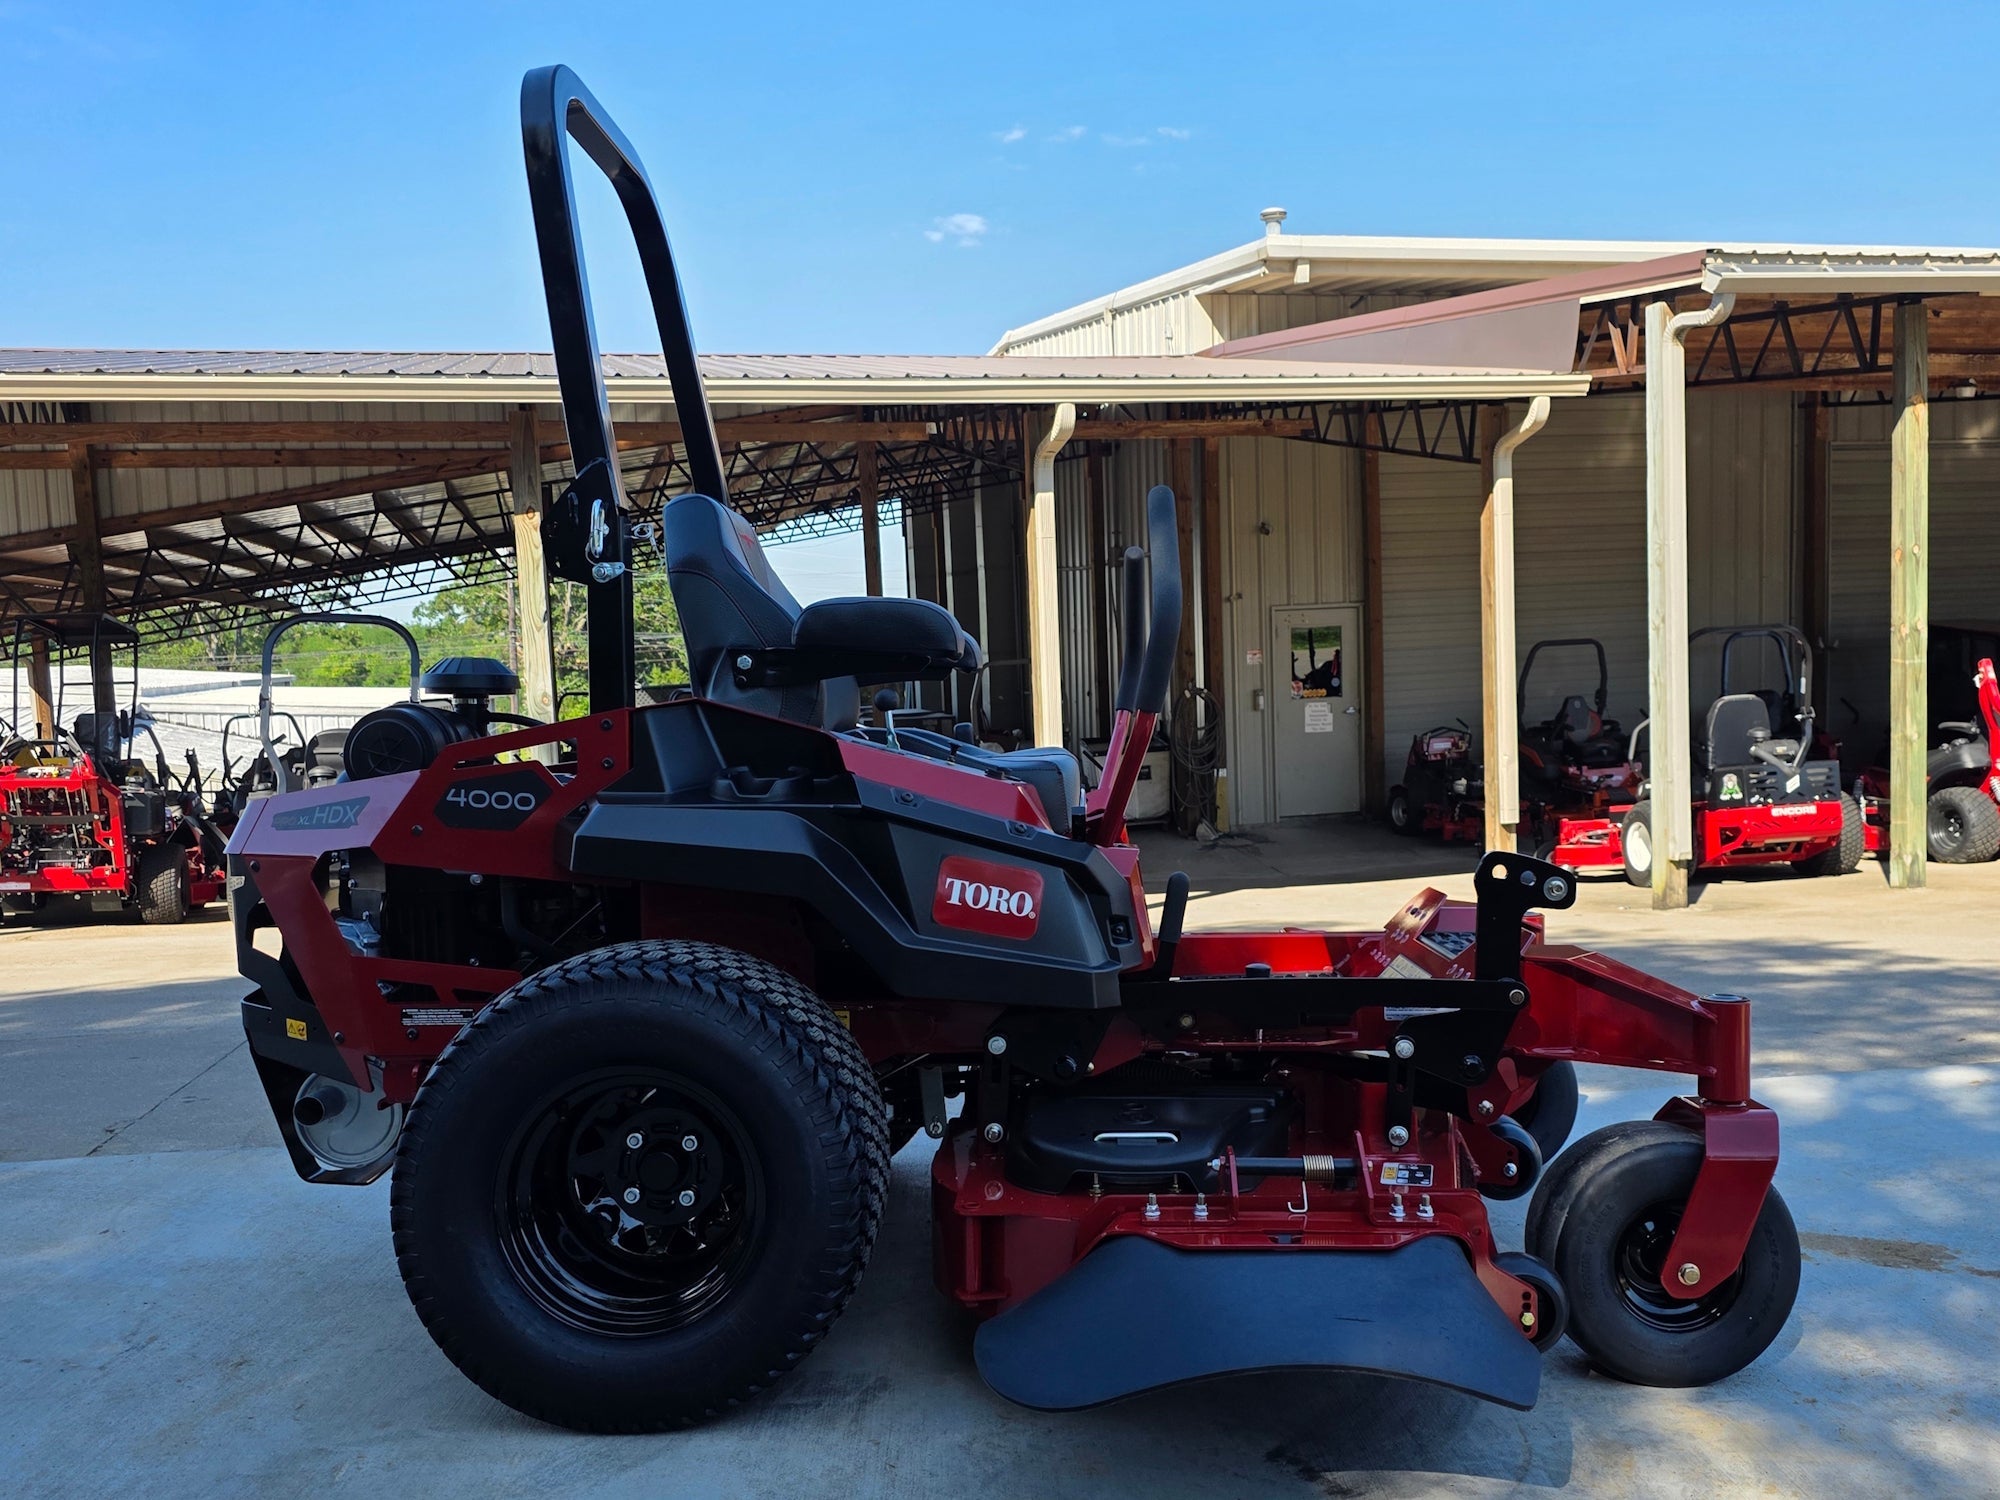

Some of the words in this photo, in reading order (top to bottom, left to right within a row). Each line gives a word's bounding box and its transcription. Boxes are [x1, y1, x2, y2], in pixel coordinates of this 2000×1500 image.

[446, 788, 536, 811] 4000
[313, 805, 360, 824] HDX
[945, 877, 1034, 918] TORO
